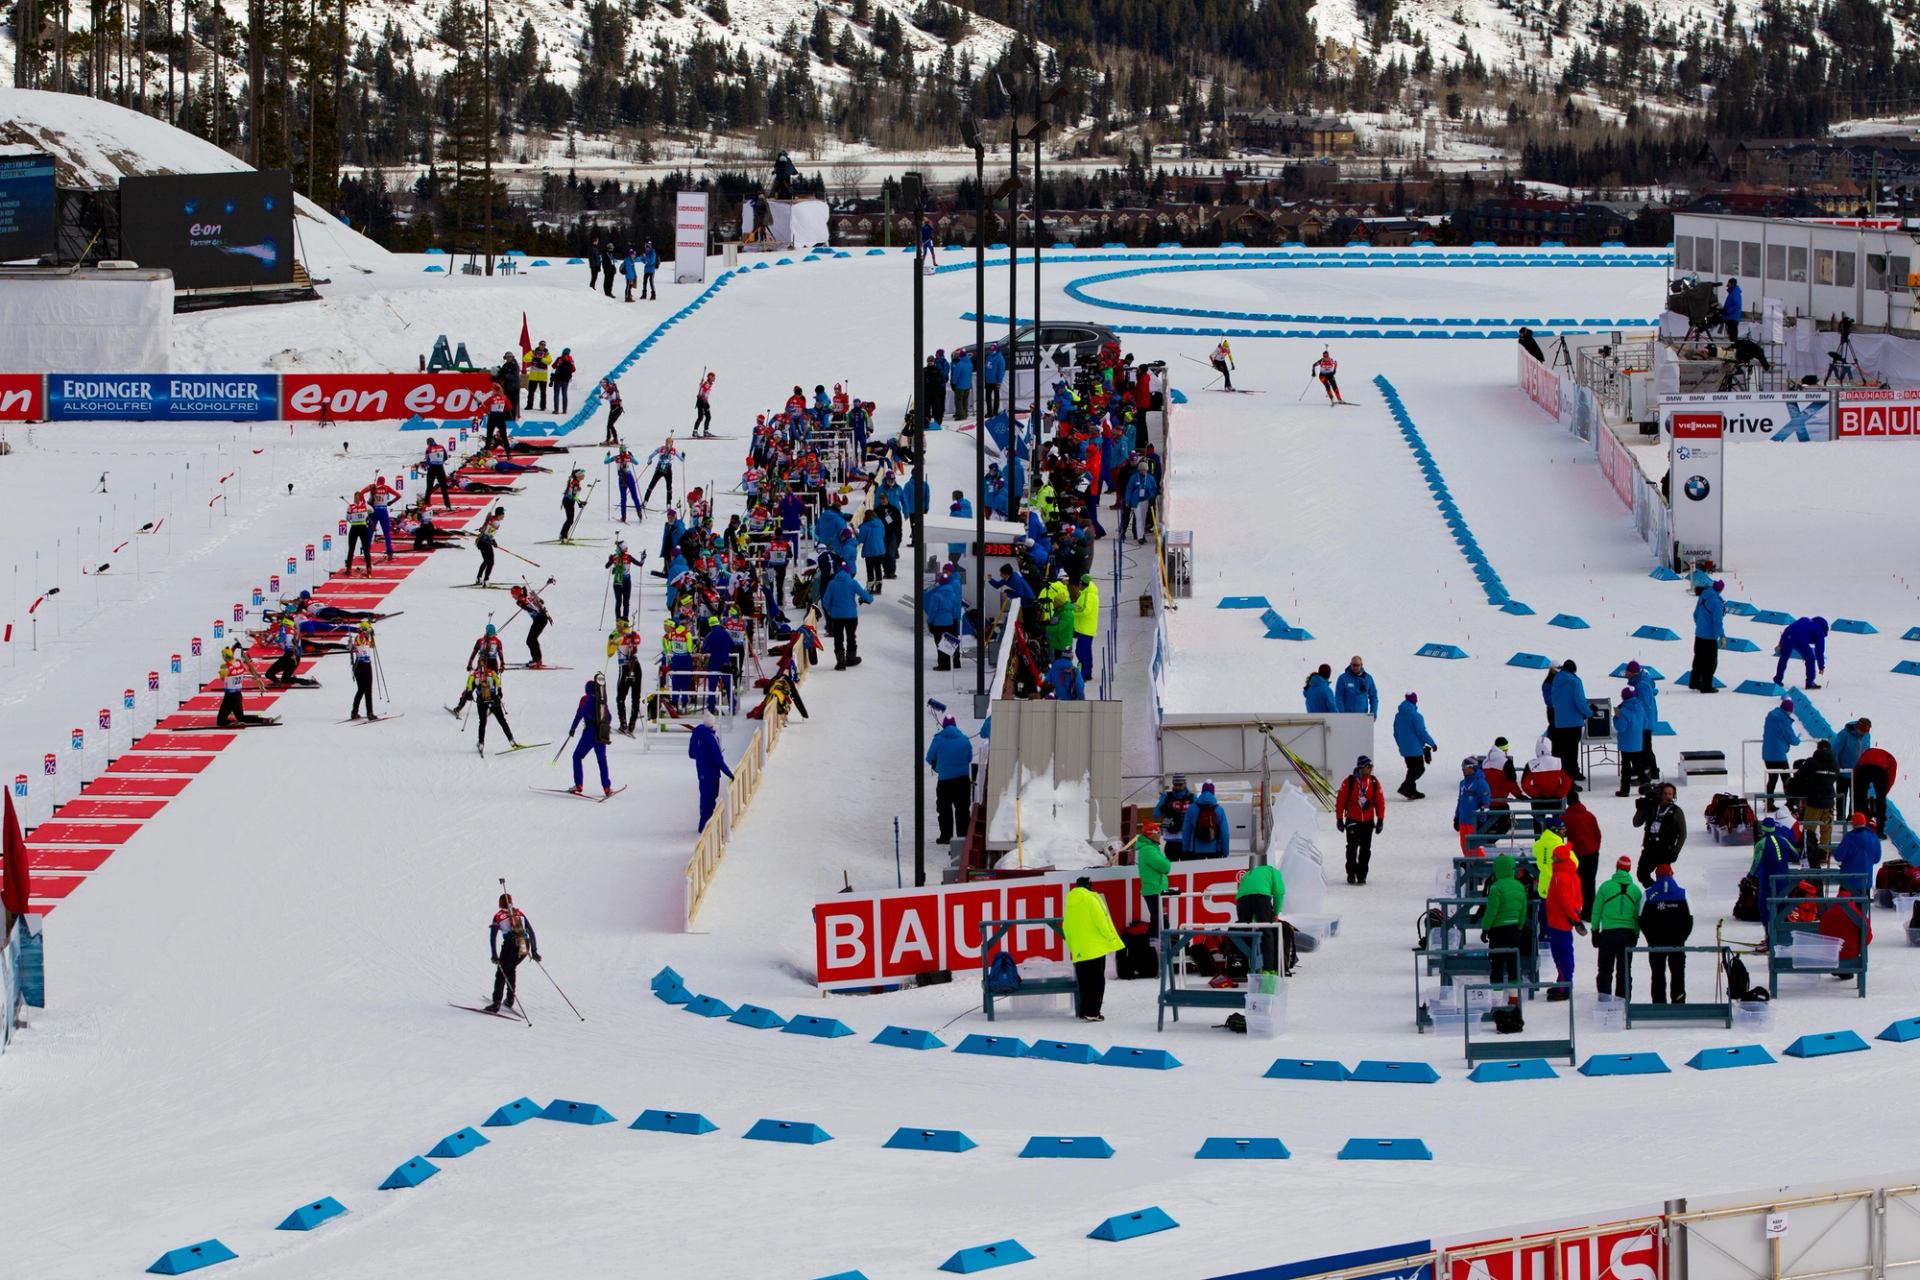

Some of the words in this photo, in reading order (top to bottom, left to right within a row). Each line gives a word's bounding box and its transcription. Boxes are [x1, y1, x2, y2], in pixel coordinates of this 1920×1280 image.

[63, 380, 154, 401] ERDINGER
[170, 380, 260, 401] ERDINGER
[1846, 391, 1894, 400] BAUHAUS
[1904, 391, 1920, 400] BA
[63, 402, 152, 411] ALKOHOLFREI
[170, 402, 259, 411] ALKOHOLFREI
[1723, 413, 1773, 434] rive
[1843, 410, 1920, 433] BAU
[340, 525, 347, 535] 12
[306, 550, 314, 560] 14
[235, 611, 243, 621] 18
[215, 627, 223, 638] 19
[193, 645, 201, 656] 20
[172, 662, 181, 672] 21
[100, 717, 110, 729] 24
[46, 762, 56, 775] 26
[17, 783, 27, 796] 27
[824, 881, 1240, 970] BAUHS
